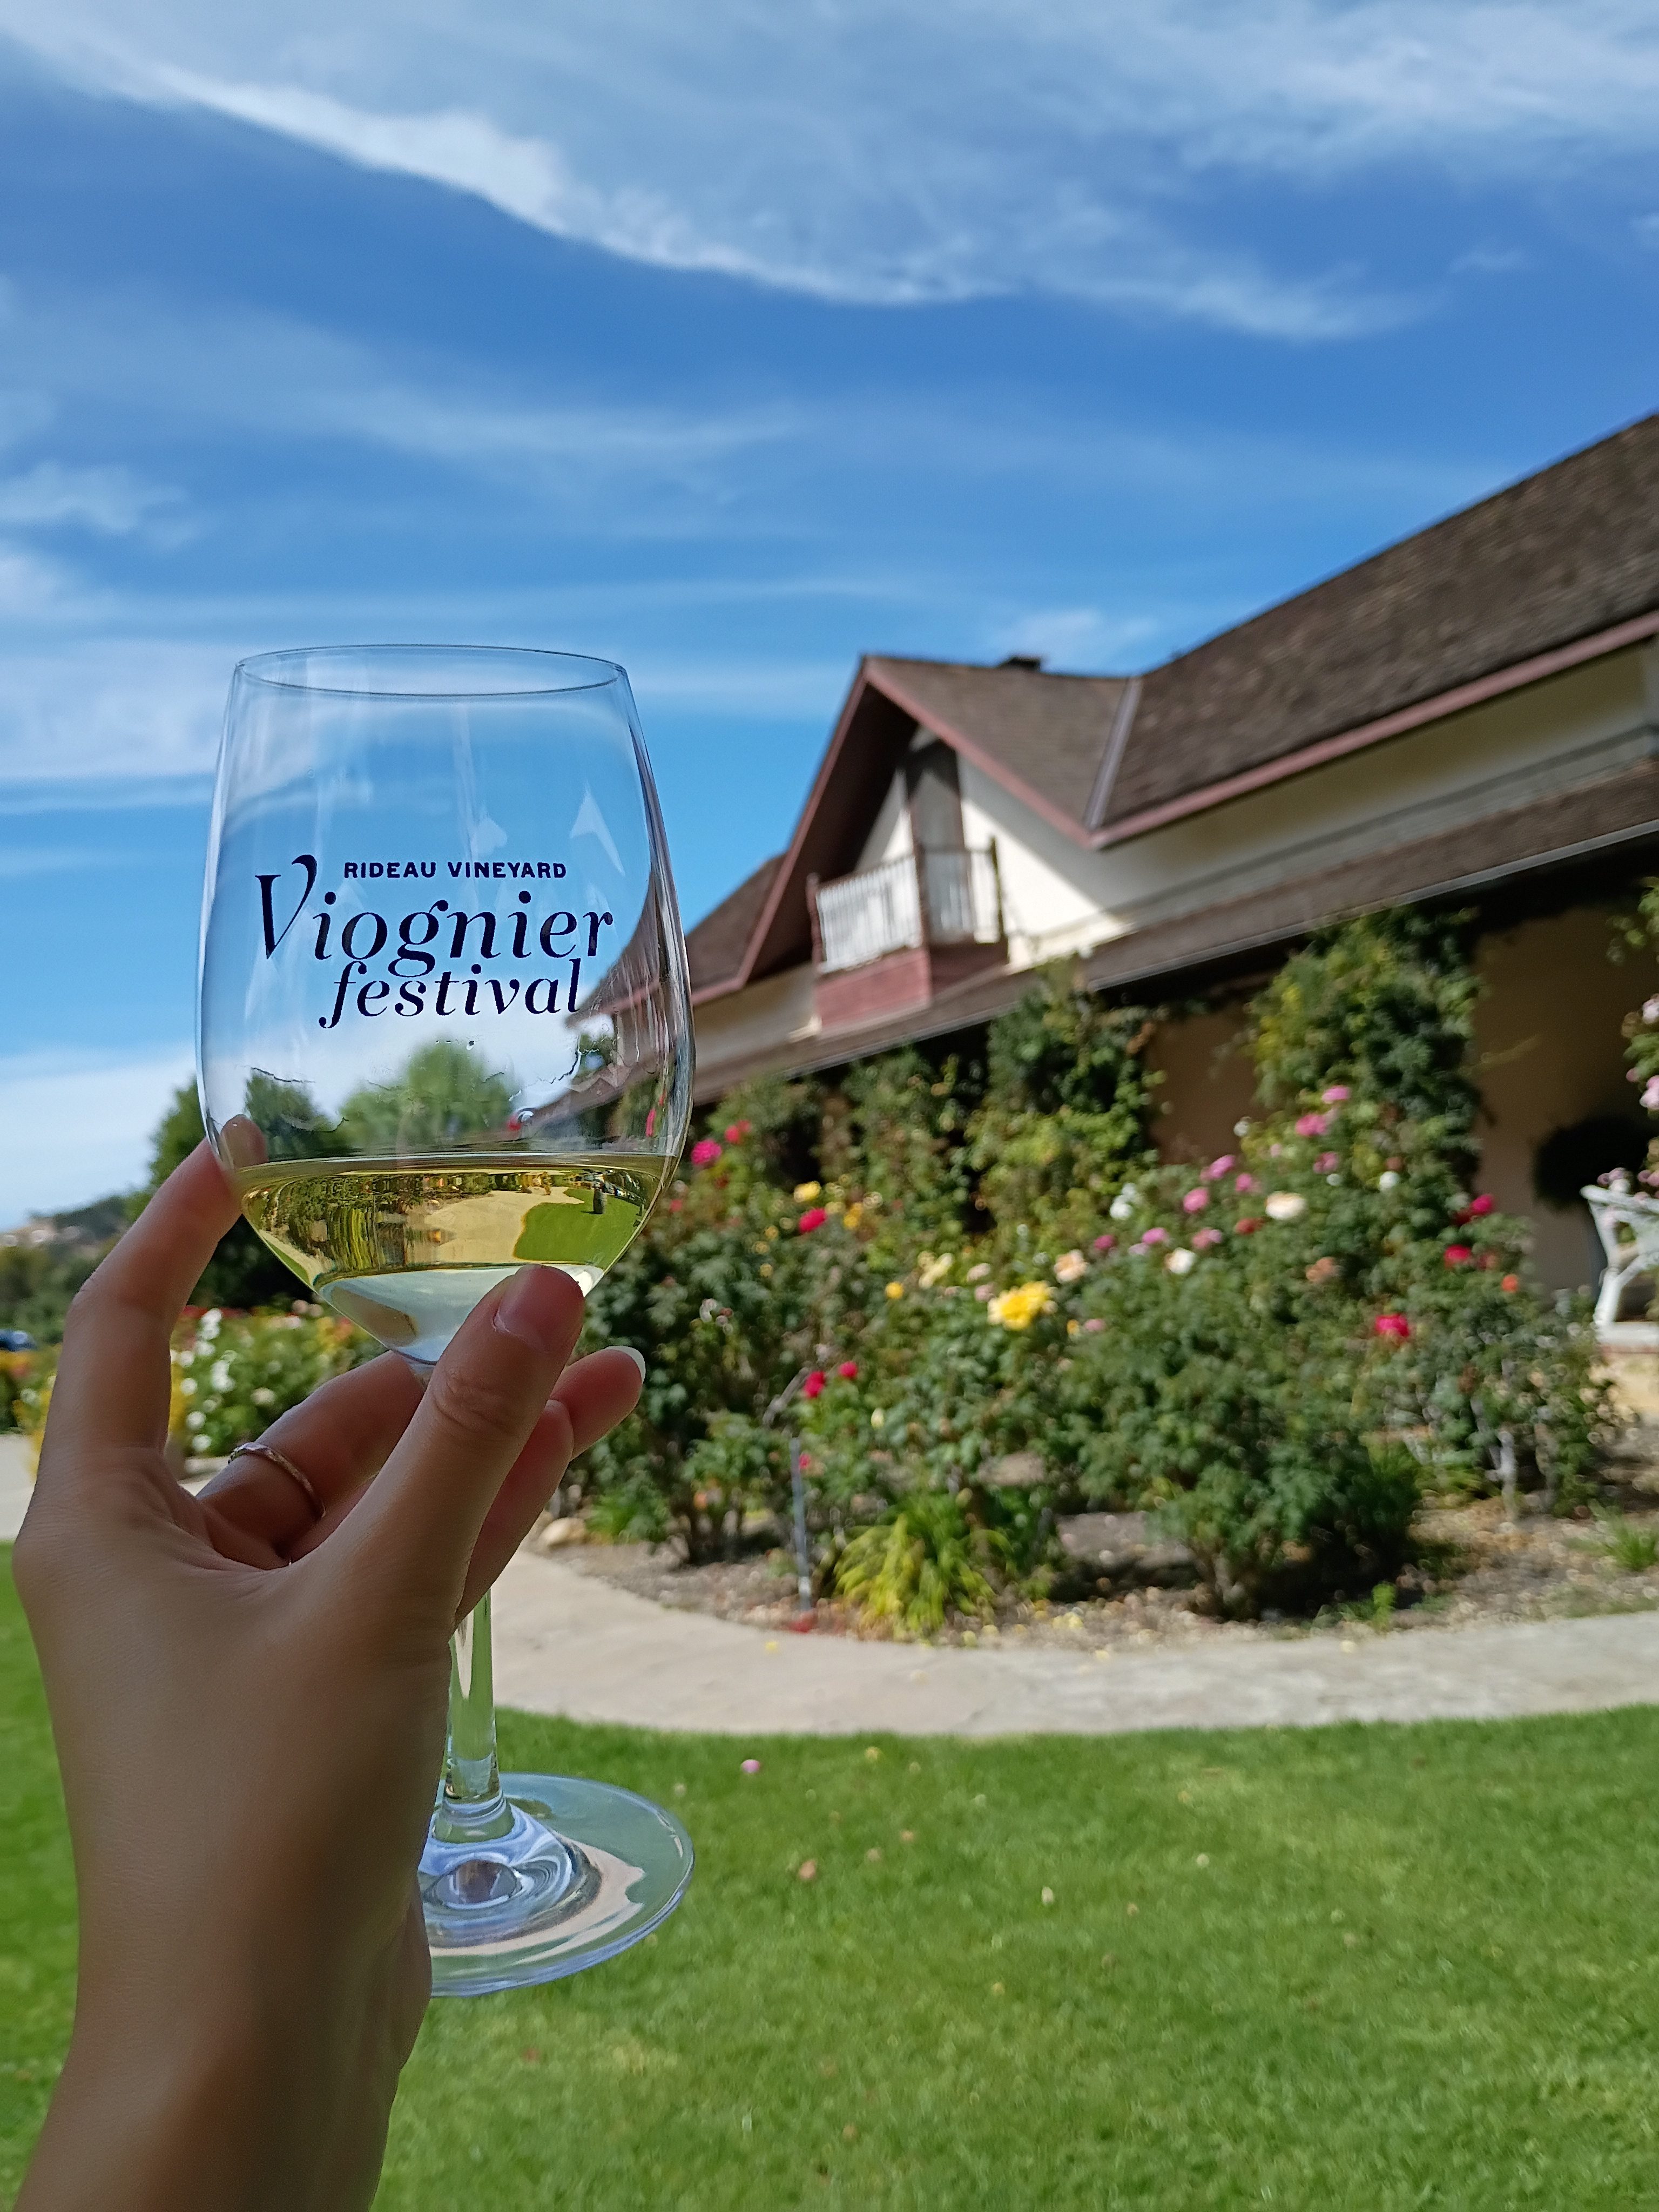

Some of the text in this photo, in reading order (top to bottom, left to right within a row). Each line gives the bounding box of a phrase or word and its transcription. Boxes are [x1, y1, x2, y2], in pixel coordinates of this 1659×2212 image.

[344, 862, 567, 878] RIDEAU VINEYARD
[255, 854, 613, 978] Viognier
[319, 959, 581, 1029] festival
